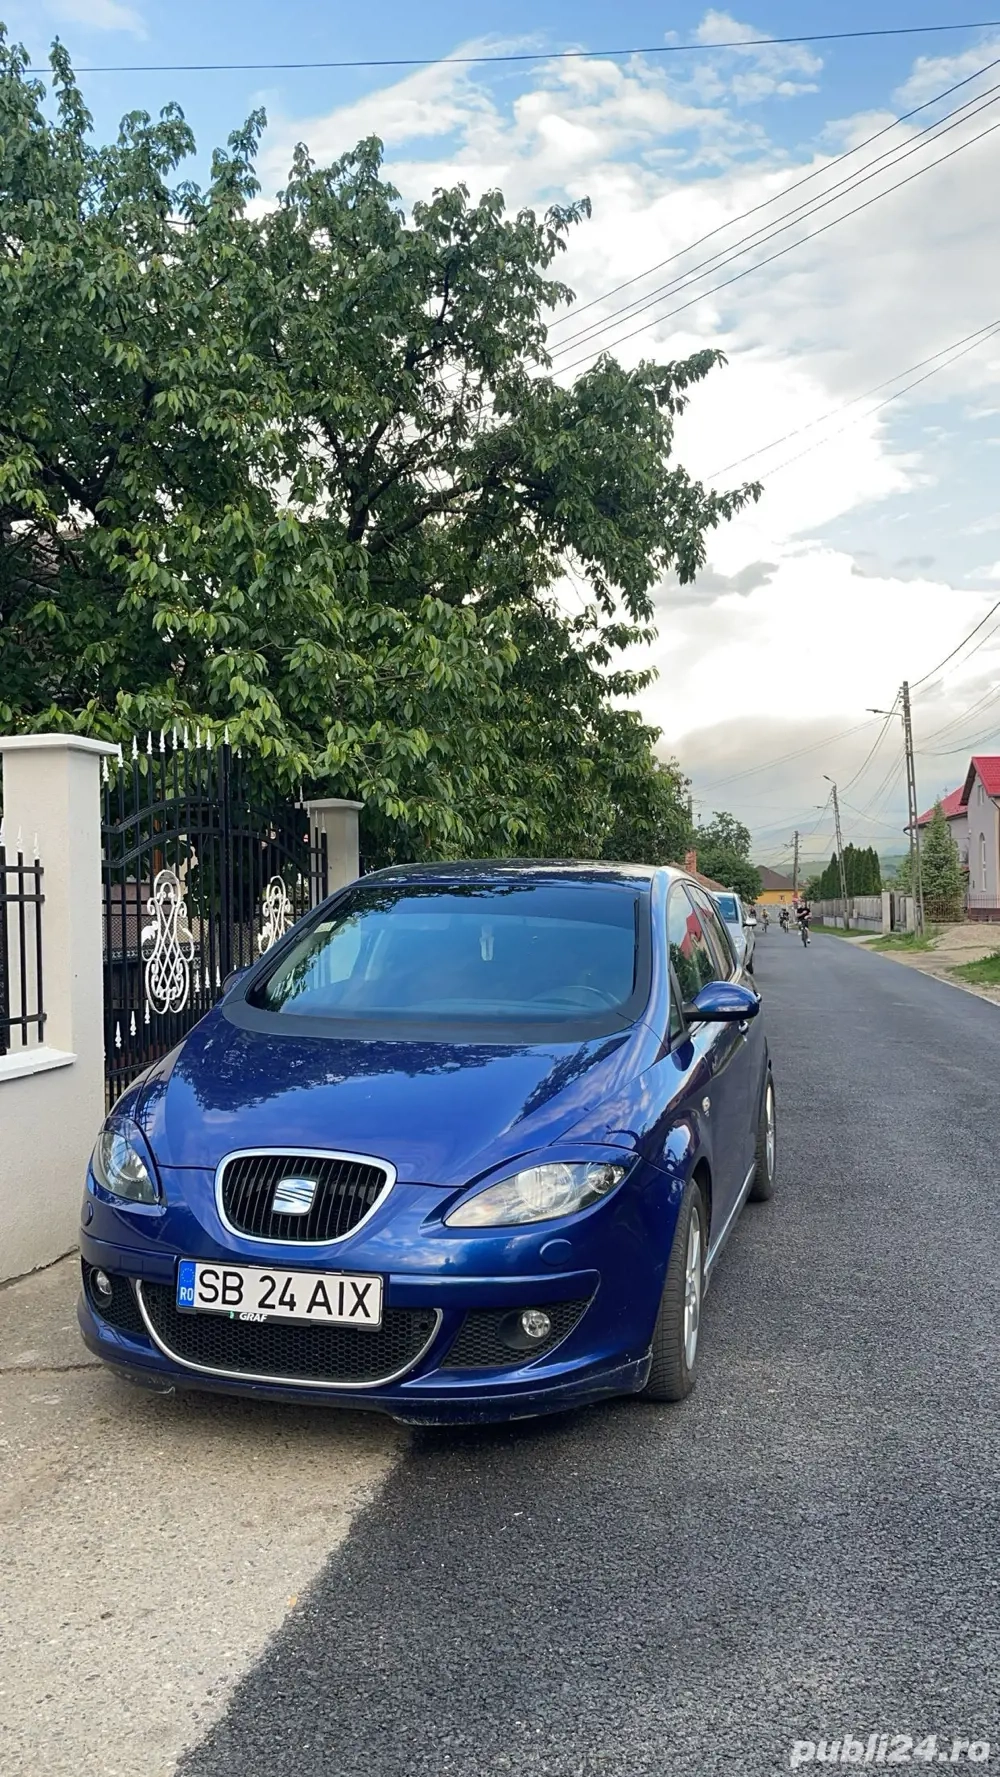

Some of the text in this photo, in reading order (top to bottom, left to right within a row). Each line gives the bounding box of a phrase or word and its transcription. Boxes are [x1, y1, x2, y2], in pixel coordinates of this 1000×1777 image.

[180, 1287, 194, 1301] RO
[198, 1269, 372, 1317] SB 24 AIX
[239, 1312, 268, 1323] GRAF
